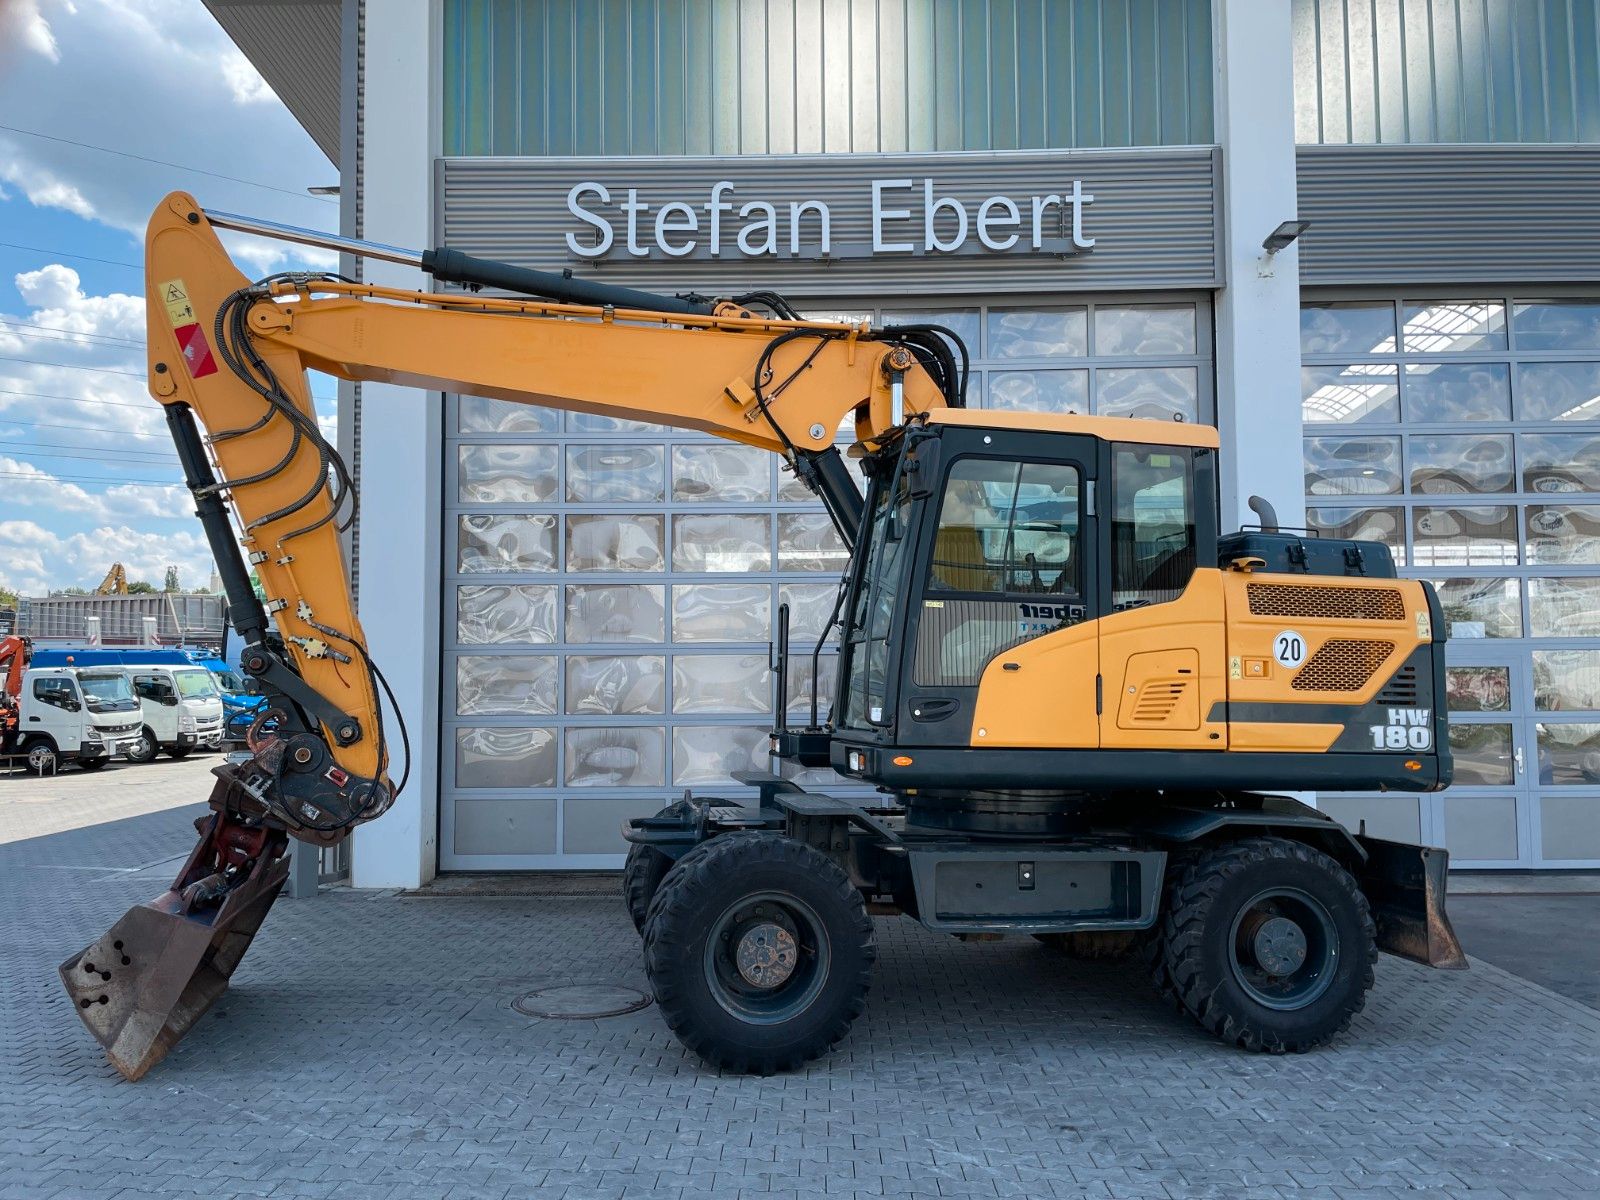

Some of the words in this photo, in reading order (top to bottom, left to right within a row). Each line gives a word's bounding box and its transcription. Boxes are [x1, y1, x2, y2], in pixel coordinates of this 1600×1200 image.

[565, 181, 830, 256] Stefan
[870, 178, 1095, 253] Ebert
[1279, 637, 1301, 662] 20
[1387, 708, 1432, 726] HW
[1369, 725, 1433, 751] 180
